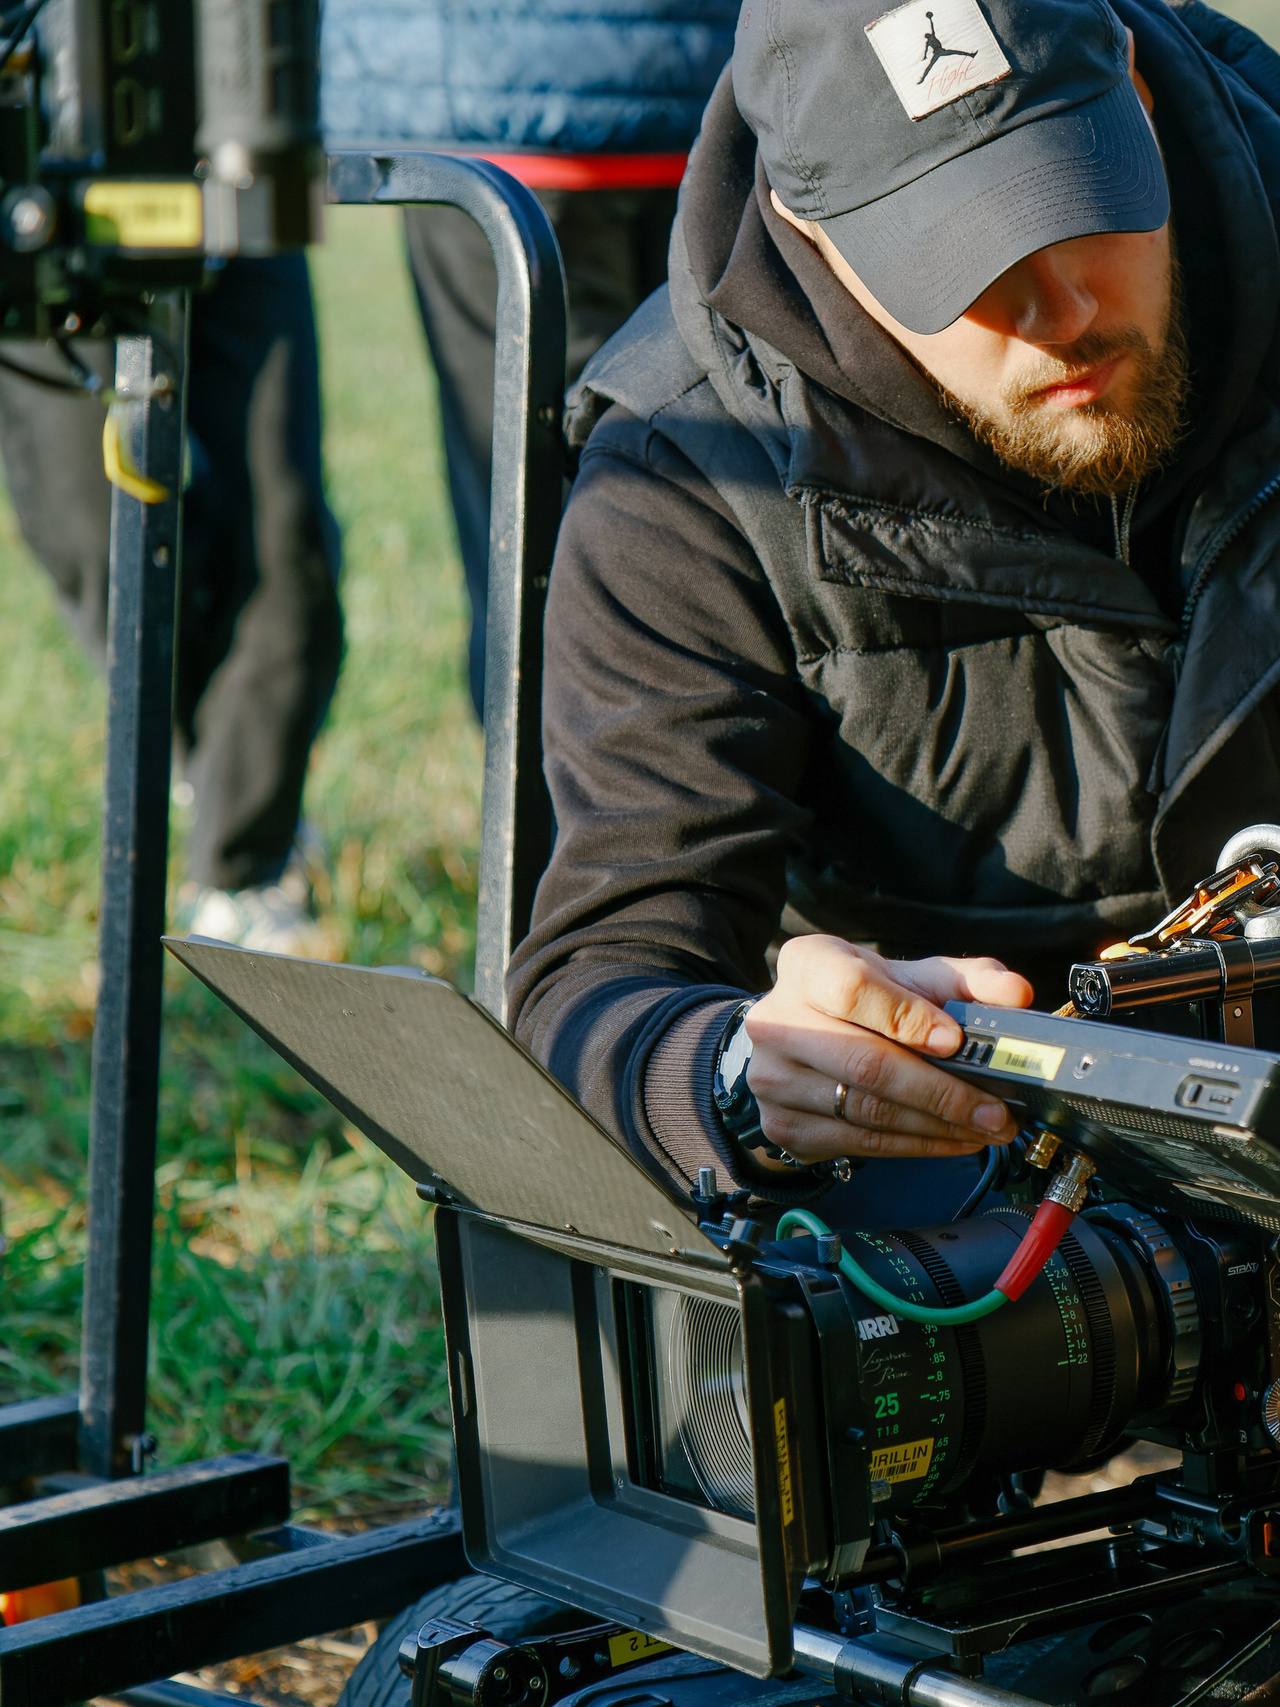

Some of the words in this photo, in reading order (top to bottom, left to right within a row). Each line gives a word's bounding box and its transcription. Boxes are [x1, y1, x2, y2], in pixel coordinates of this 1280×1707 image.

[888, 1258, 904, 1266] 1.4
[895, 1266, 910, 1275] 1.3
[1054, 1268, 1069, 1278] 2.8
[903, 1277, 918, 1286] 1.2
[1061, 1282, 1068, 1291] 4
[911, 1291, 925, 1302] 1.1
[1065, 1294, 1079, 1306] 5.6
[1069, 1310, 1076, 1320] 8
[1073, 1324, 1084, 1335] 11
[1076, 1338, 1087, 1349] 16
[1077, 1353, 1088, 1364] 22
[874, 1392, 900, 1419] 25
[871, 1444, 928, 1468] IRILLIN
